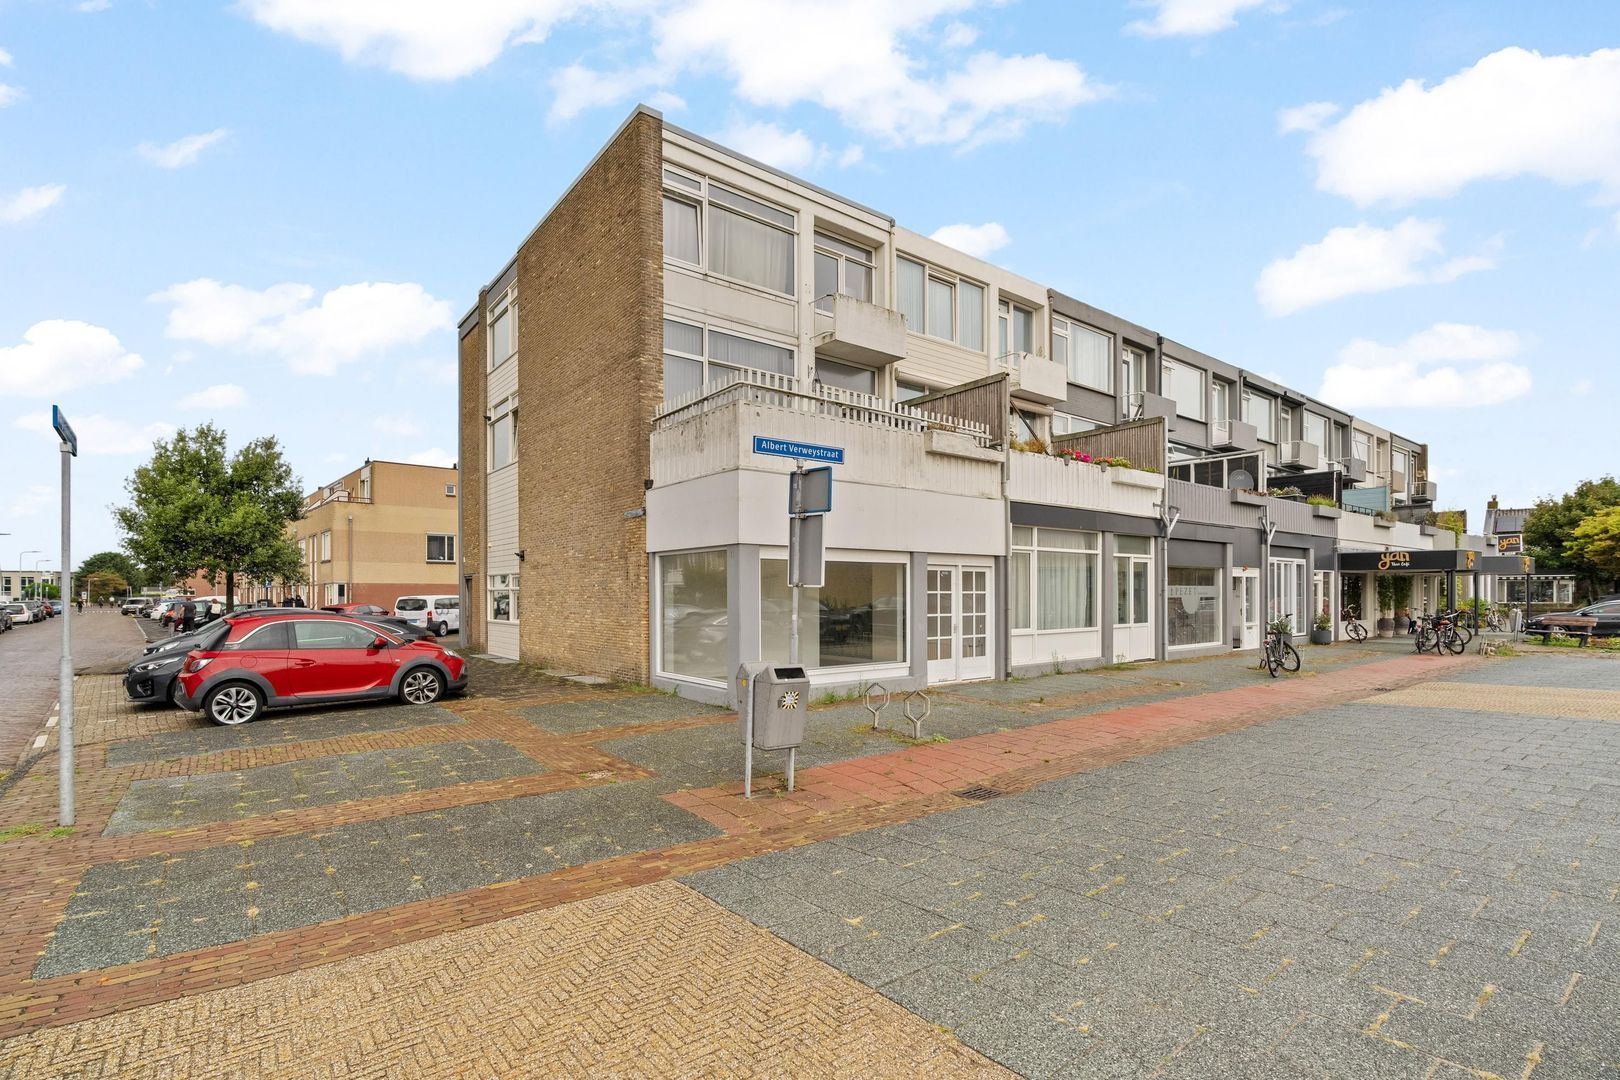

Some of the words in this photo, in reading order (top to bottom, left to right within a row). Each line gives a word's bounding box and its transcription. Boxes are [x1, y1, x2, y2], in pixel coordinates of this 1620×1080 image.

[761, 440, 787, 451] Albert
[789, 444, 839, 458] Verweystraat
[1498, 537, 1520, 550] yan
[1378, 552, 1410, 570] yan
